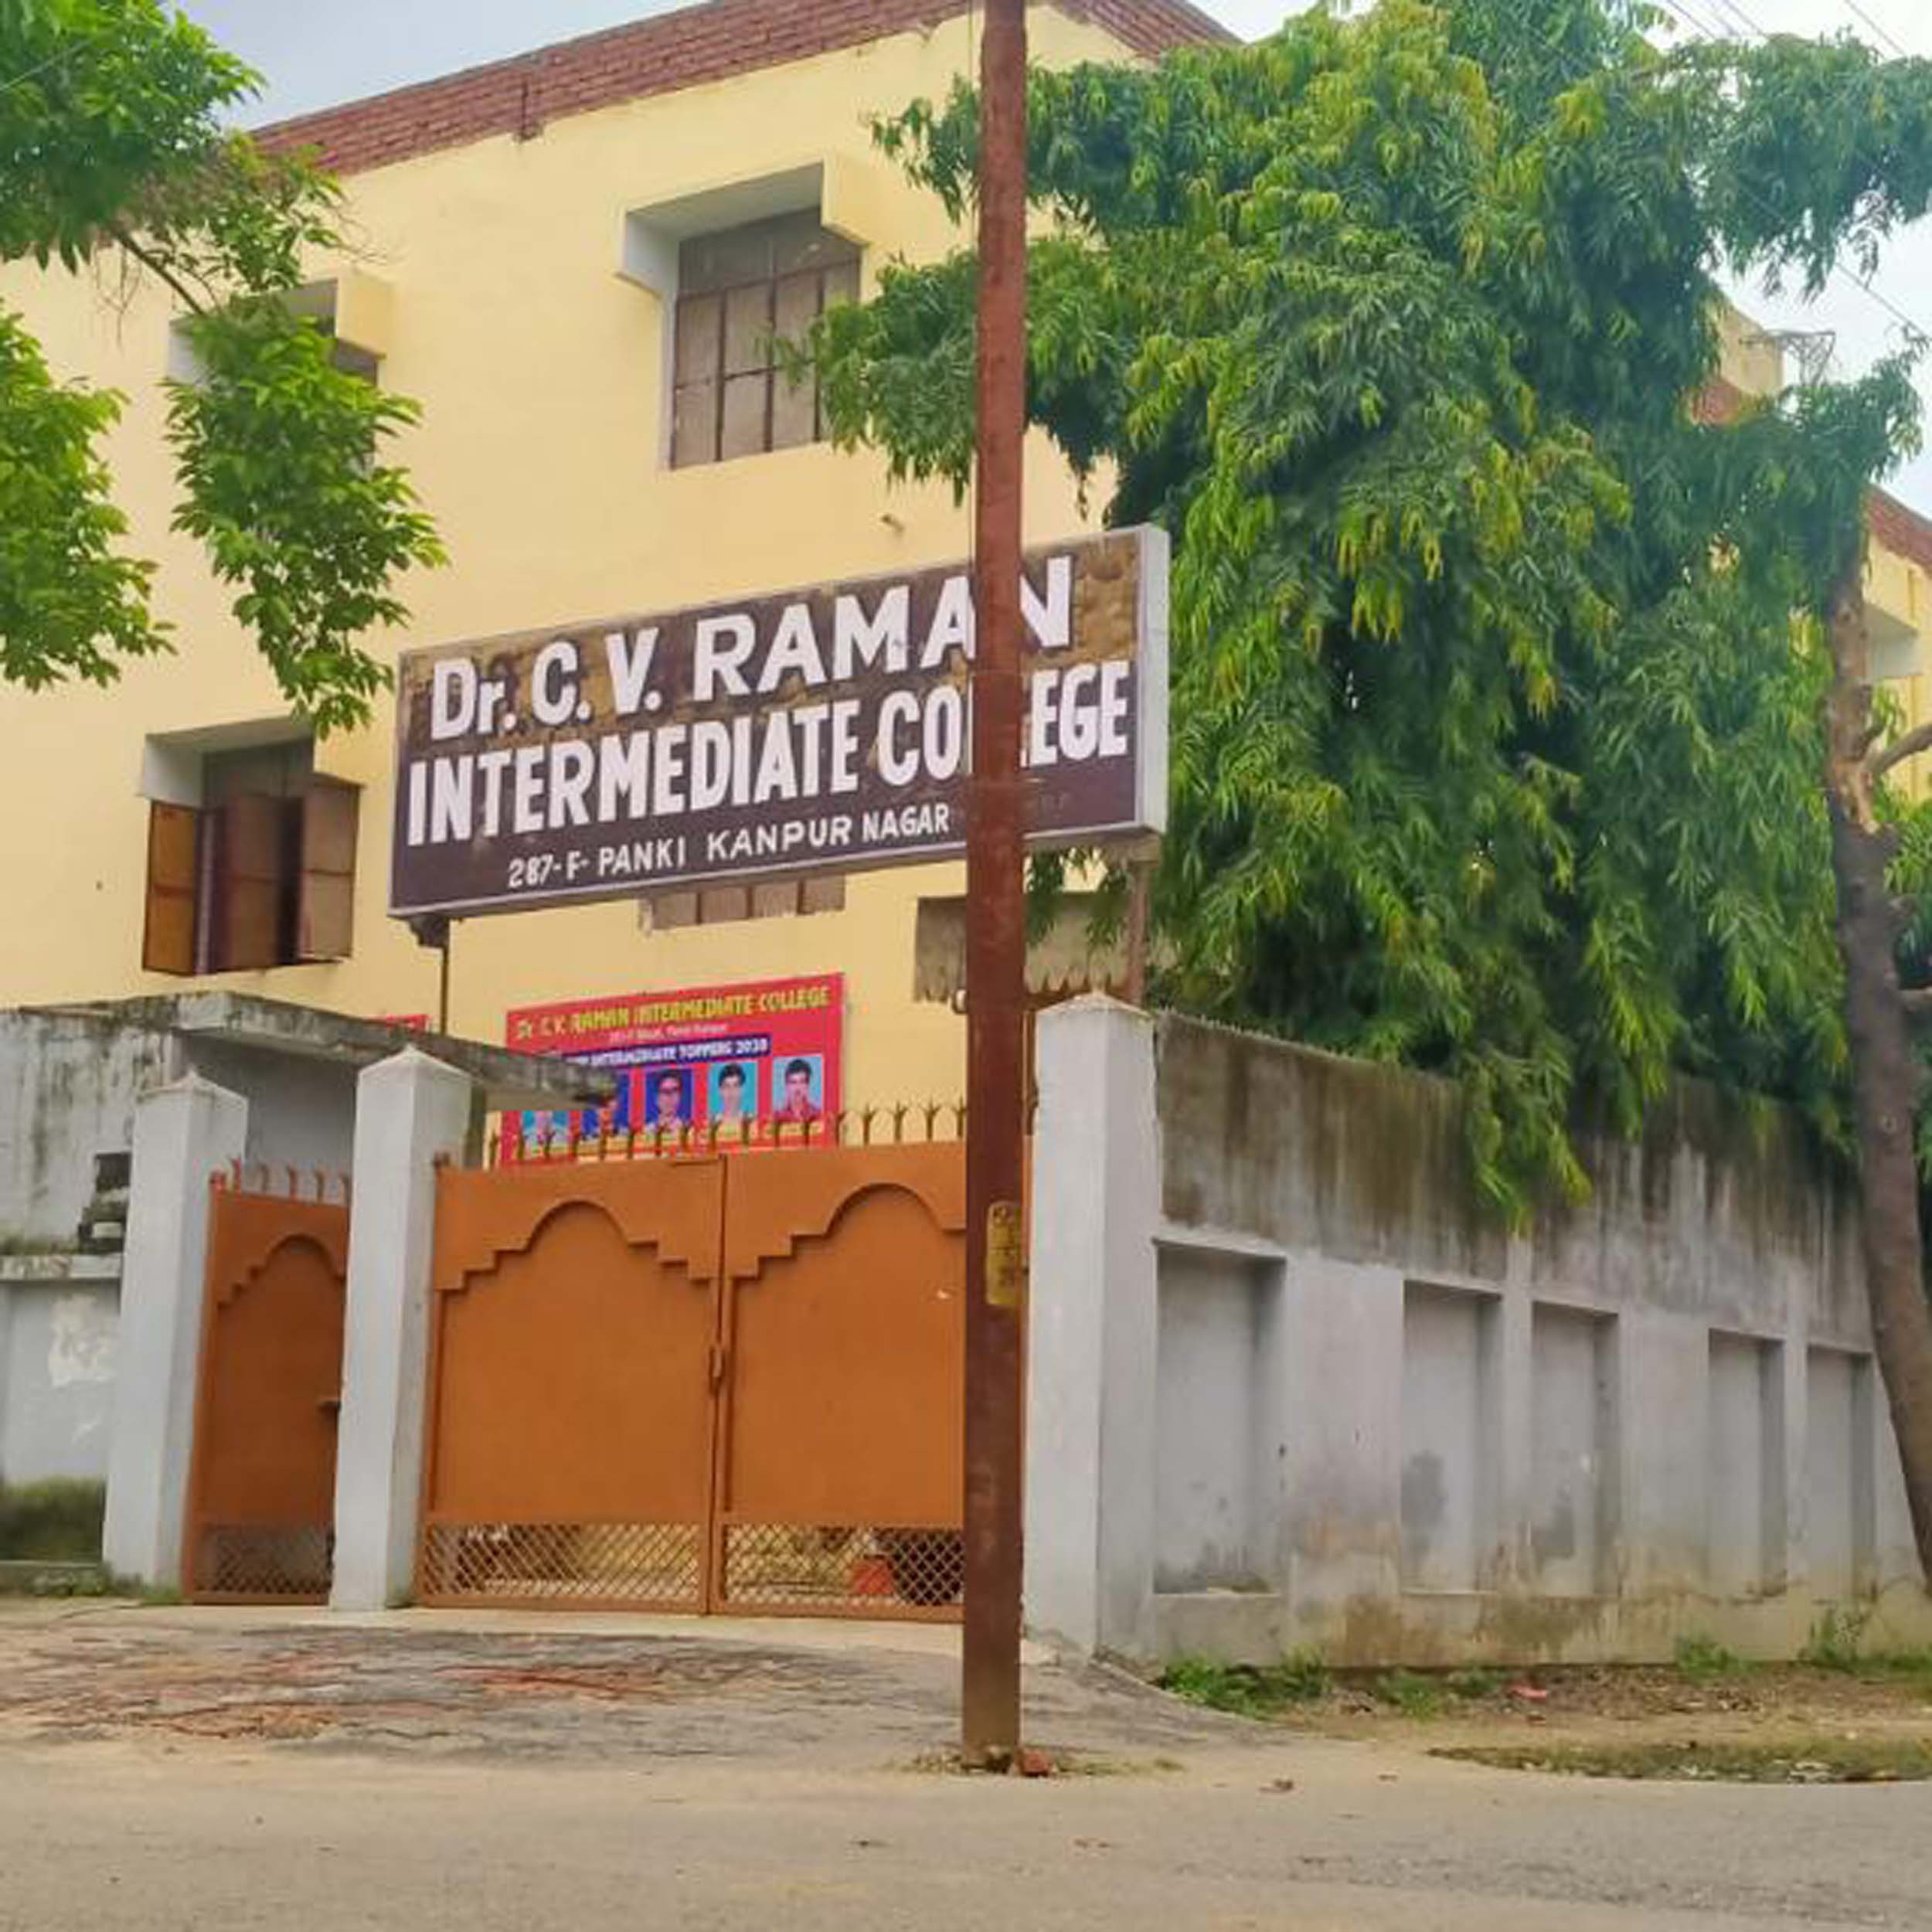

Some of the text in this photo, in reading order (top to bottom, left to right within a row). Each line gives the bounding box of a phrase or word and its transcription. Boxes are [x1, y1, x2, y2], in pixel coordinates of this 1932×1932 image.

[430, 555, 1072, 741] Dr. C. V. RAMAN
[407, 659, 1131, 847] INTERMEDIATE COEGE
[598, 835, 686, 877] PANKI
[706, 815, 852, 862] KANPUR
[862, 802, 950, 843] NAGAR
[634, 994, 754, 1026] INTERMEDIATE
[760, 985, 830, 1011] COLLEGE
